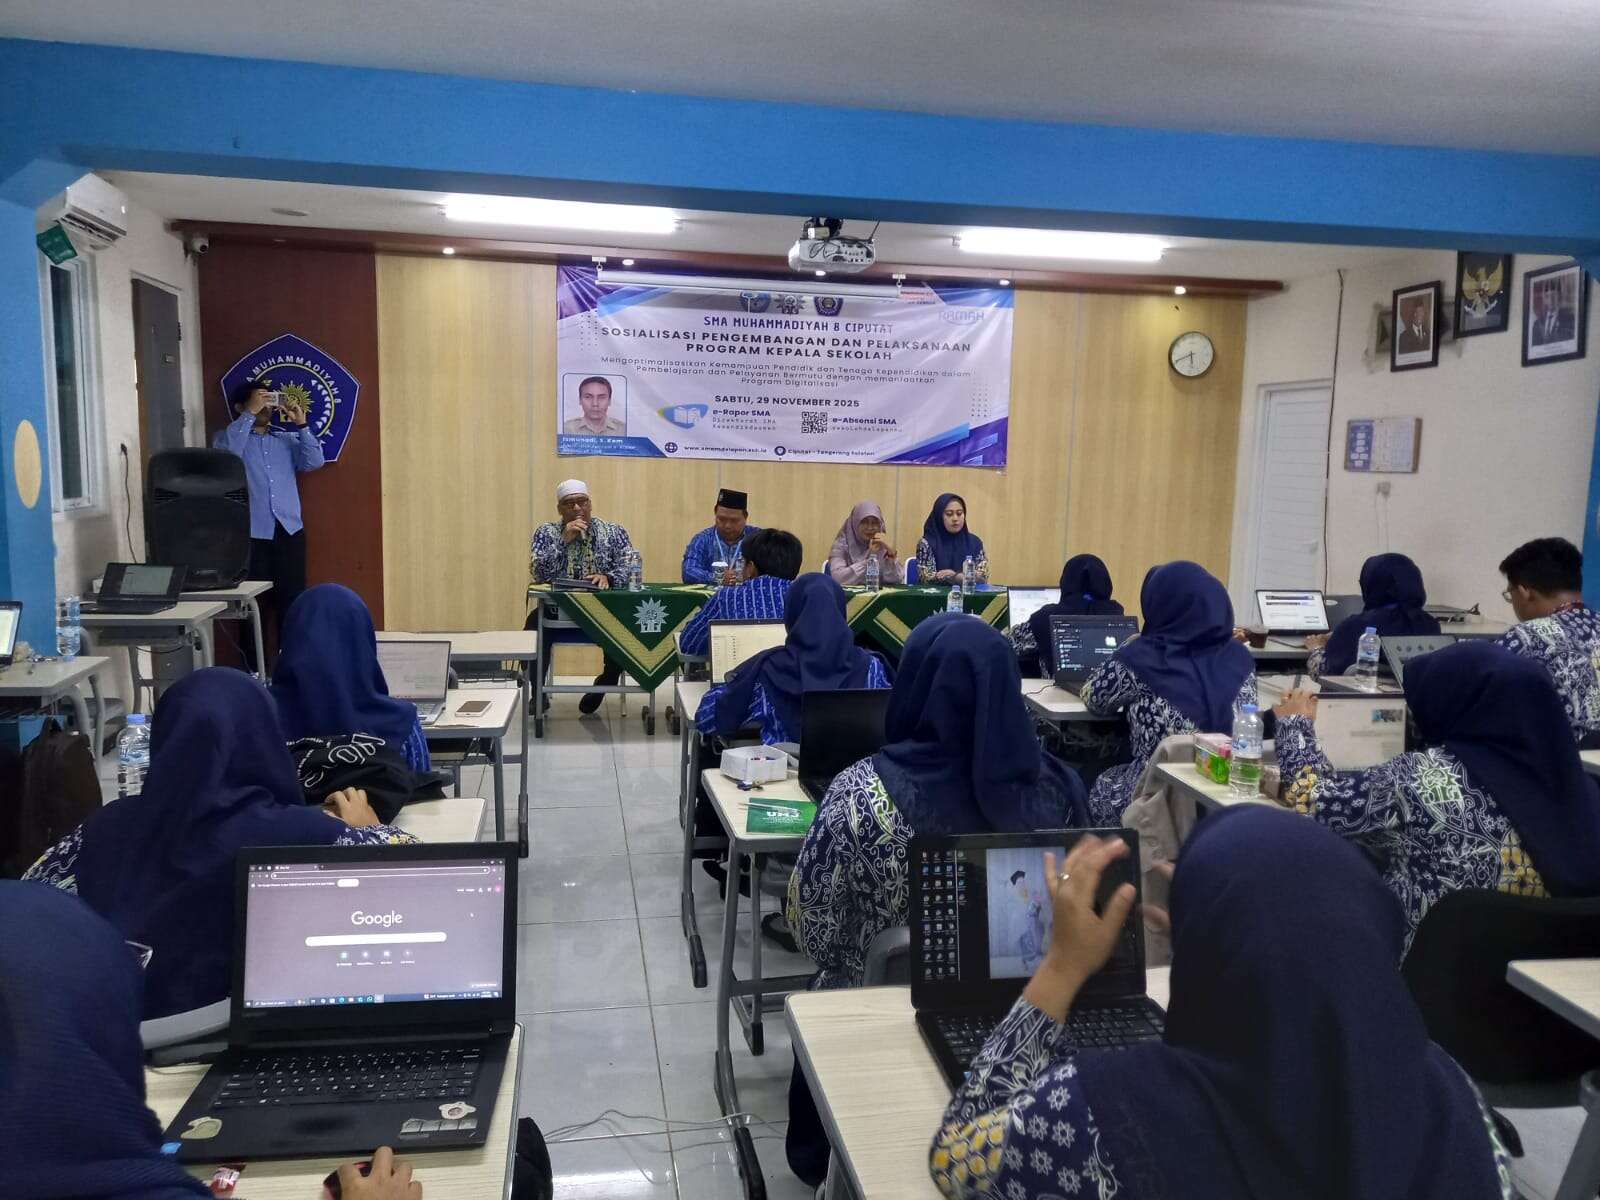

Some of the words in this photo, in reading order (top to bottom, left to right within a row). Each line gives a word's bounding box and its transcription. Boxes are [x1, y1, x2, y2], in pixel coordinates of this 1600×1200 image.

[704, 317, 728, 326] SMA
[733, 318, 829, 331] MUHAMMADIYAH
[833, 323, 840, 332] 8
[845, 322, 894, 334] CIPUTAT
[601, 327, 696, 340] SOSIALISASI
[702, 332, 826, 346] PENGEMBANGAN
[831, 338, 862, 349] DAN
[867, 340, 971, 352] PELAKSANAAN
[686, 343, 760, 355] PROGRAM
[766, 347, 822, 358] KEPALA
[826, 350, 892, 360] SEKOLAH
[252, 355, 339, 394] MUHAMMADIYAH
[636, 365, 705, 376] Pembelajaran
[708, 368, 727, 376] dan
[729, 368, 780, 379] Pelayanan
[783, 371, 823, 379] Bermutu
[826, 372, 862, 382] dengan
[709, 361, 770, 371] Kemampuan
[773, 363, 814, 372] Pendidik
[817, 366, 835, 374] dan
[838, 366, 873, 375] Tenaga
[741, 377, 783, 387] Program
[786, 378, 838, 388] Digitalisasi
[714, 395, 754, 405] SABTU,
[757, 396, 770, 405] 29
[772, 396, 831, 408] NOVEMBER
[834, 400, 860, 408] 2025
[712, 408, 748, 416] e-Rapor
[351, 910, 404, 927] Google
